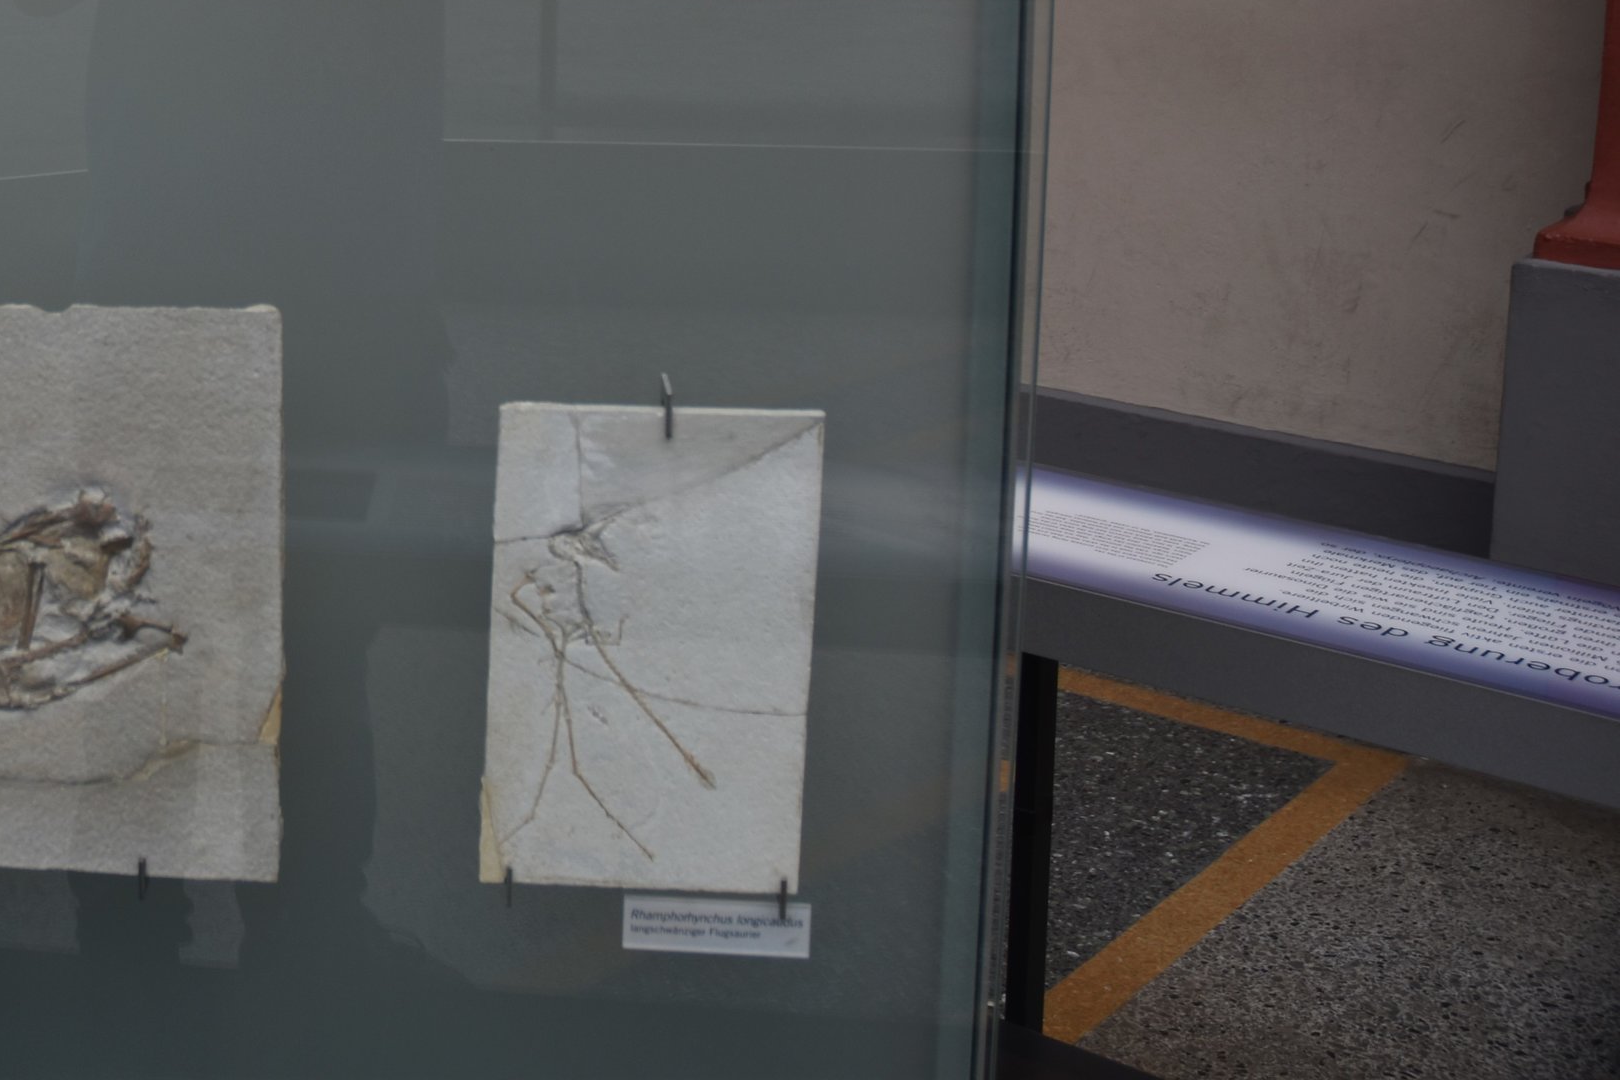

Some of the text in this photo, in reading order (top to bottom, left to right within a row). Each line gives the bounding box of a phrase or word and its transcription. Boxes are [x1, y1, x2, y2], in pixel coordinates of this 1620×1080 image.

[1311, 554, 1346, 564] noch
[1323, 549, 1395, 568] Merkmale
[1328, 565, 1376, 578] hatten
[1352, 563, 1394, 575] heute
[1244, 567, 1327, 589] Dinosaurier
[1289, 570, 1344, 585] Flügeln
[1383, 577, 1448, 594] Insekten
[1149, 573, 1319, 617] Himmels
[1333, 595, 1364, 605] sich
[1362, 594, 1387, 602] wie
[1387, 585, 1459, 604] Luftraum
[1455, 593, 1494, 604] Viele
[1466, 603, 1498, 613] Den
[1508, 598, 1548, 609] auch
[1370, 603, 1460, 626] schwangen
[1422, 608, 1454, 618] sind
[1337, 616, 1409, 638] des
[1370, 611, 1455, 633] fliegenden
[1461, 617, 1511, 631] Heute
[1460, 632, 1501, 644] aktiv
[1464, 626, 1519, 641] Jahren
[1571, 635, 1615, 647] ihren
[1575, 643, 1602, 652] die
[1507, 643, 1563, 658] ersten
[1526, 640, 1607, 661] Millionen
[1569, 658, 1596, 666] die
